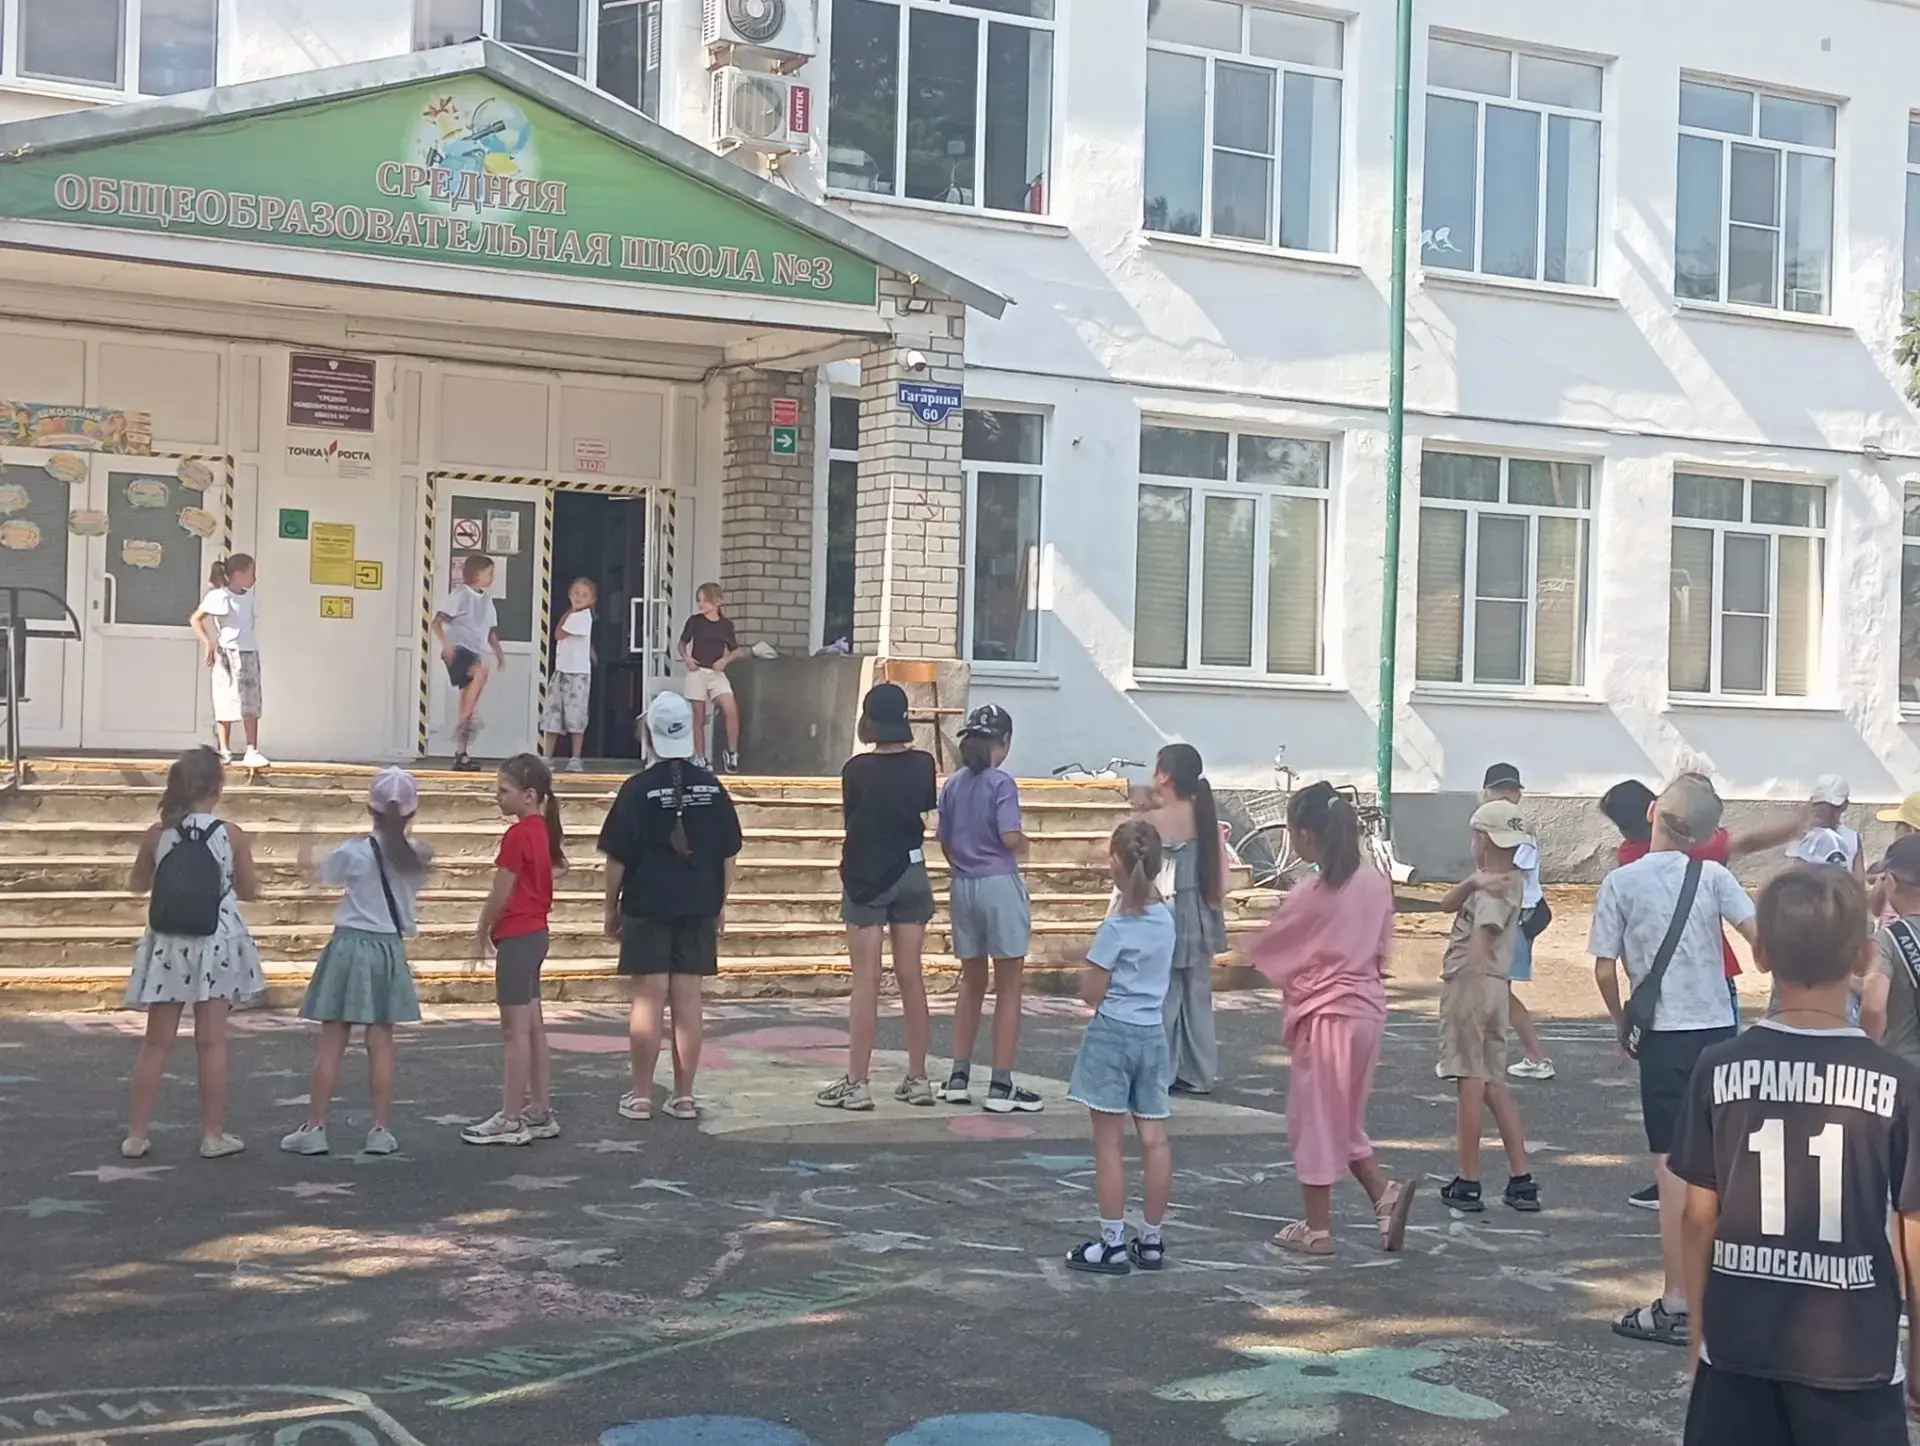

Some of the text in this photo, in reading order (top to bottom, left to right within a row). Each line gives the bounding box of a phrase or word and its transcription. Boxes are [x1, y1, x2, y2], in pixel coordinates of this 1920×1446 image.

[795, 88, 805, 132] CENTEK
[376, 161, 567, 215] СРЕДНЯЯ
[54, 173, 833, 289] ОБЩЕОБРАЗОВАТЕЛЬНАЯ ШКОЛА №3
[901, 389, 959, 407] Гагарина
[922, 408, 938, 421] 60
[288, 446, 371, 461] ТОЧКА РОСТА
[1713, 1059, 1898, 1118] КАРАМЫШЕВ
[1748, 1118, 1844, 1243] 11
[1712, 1239, 1875, 1290] НОВОСЕЛИЦКОЕ
